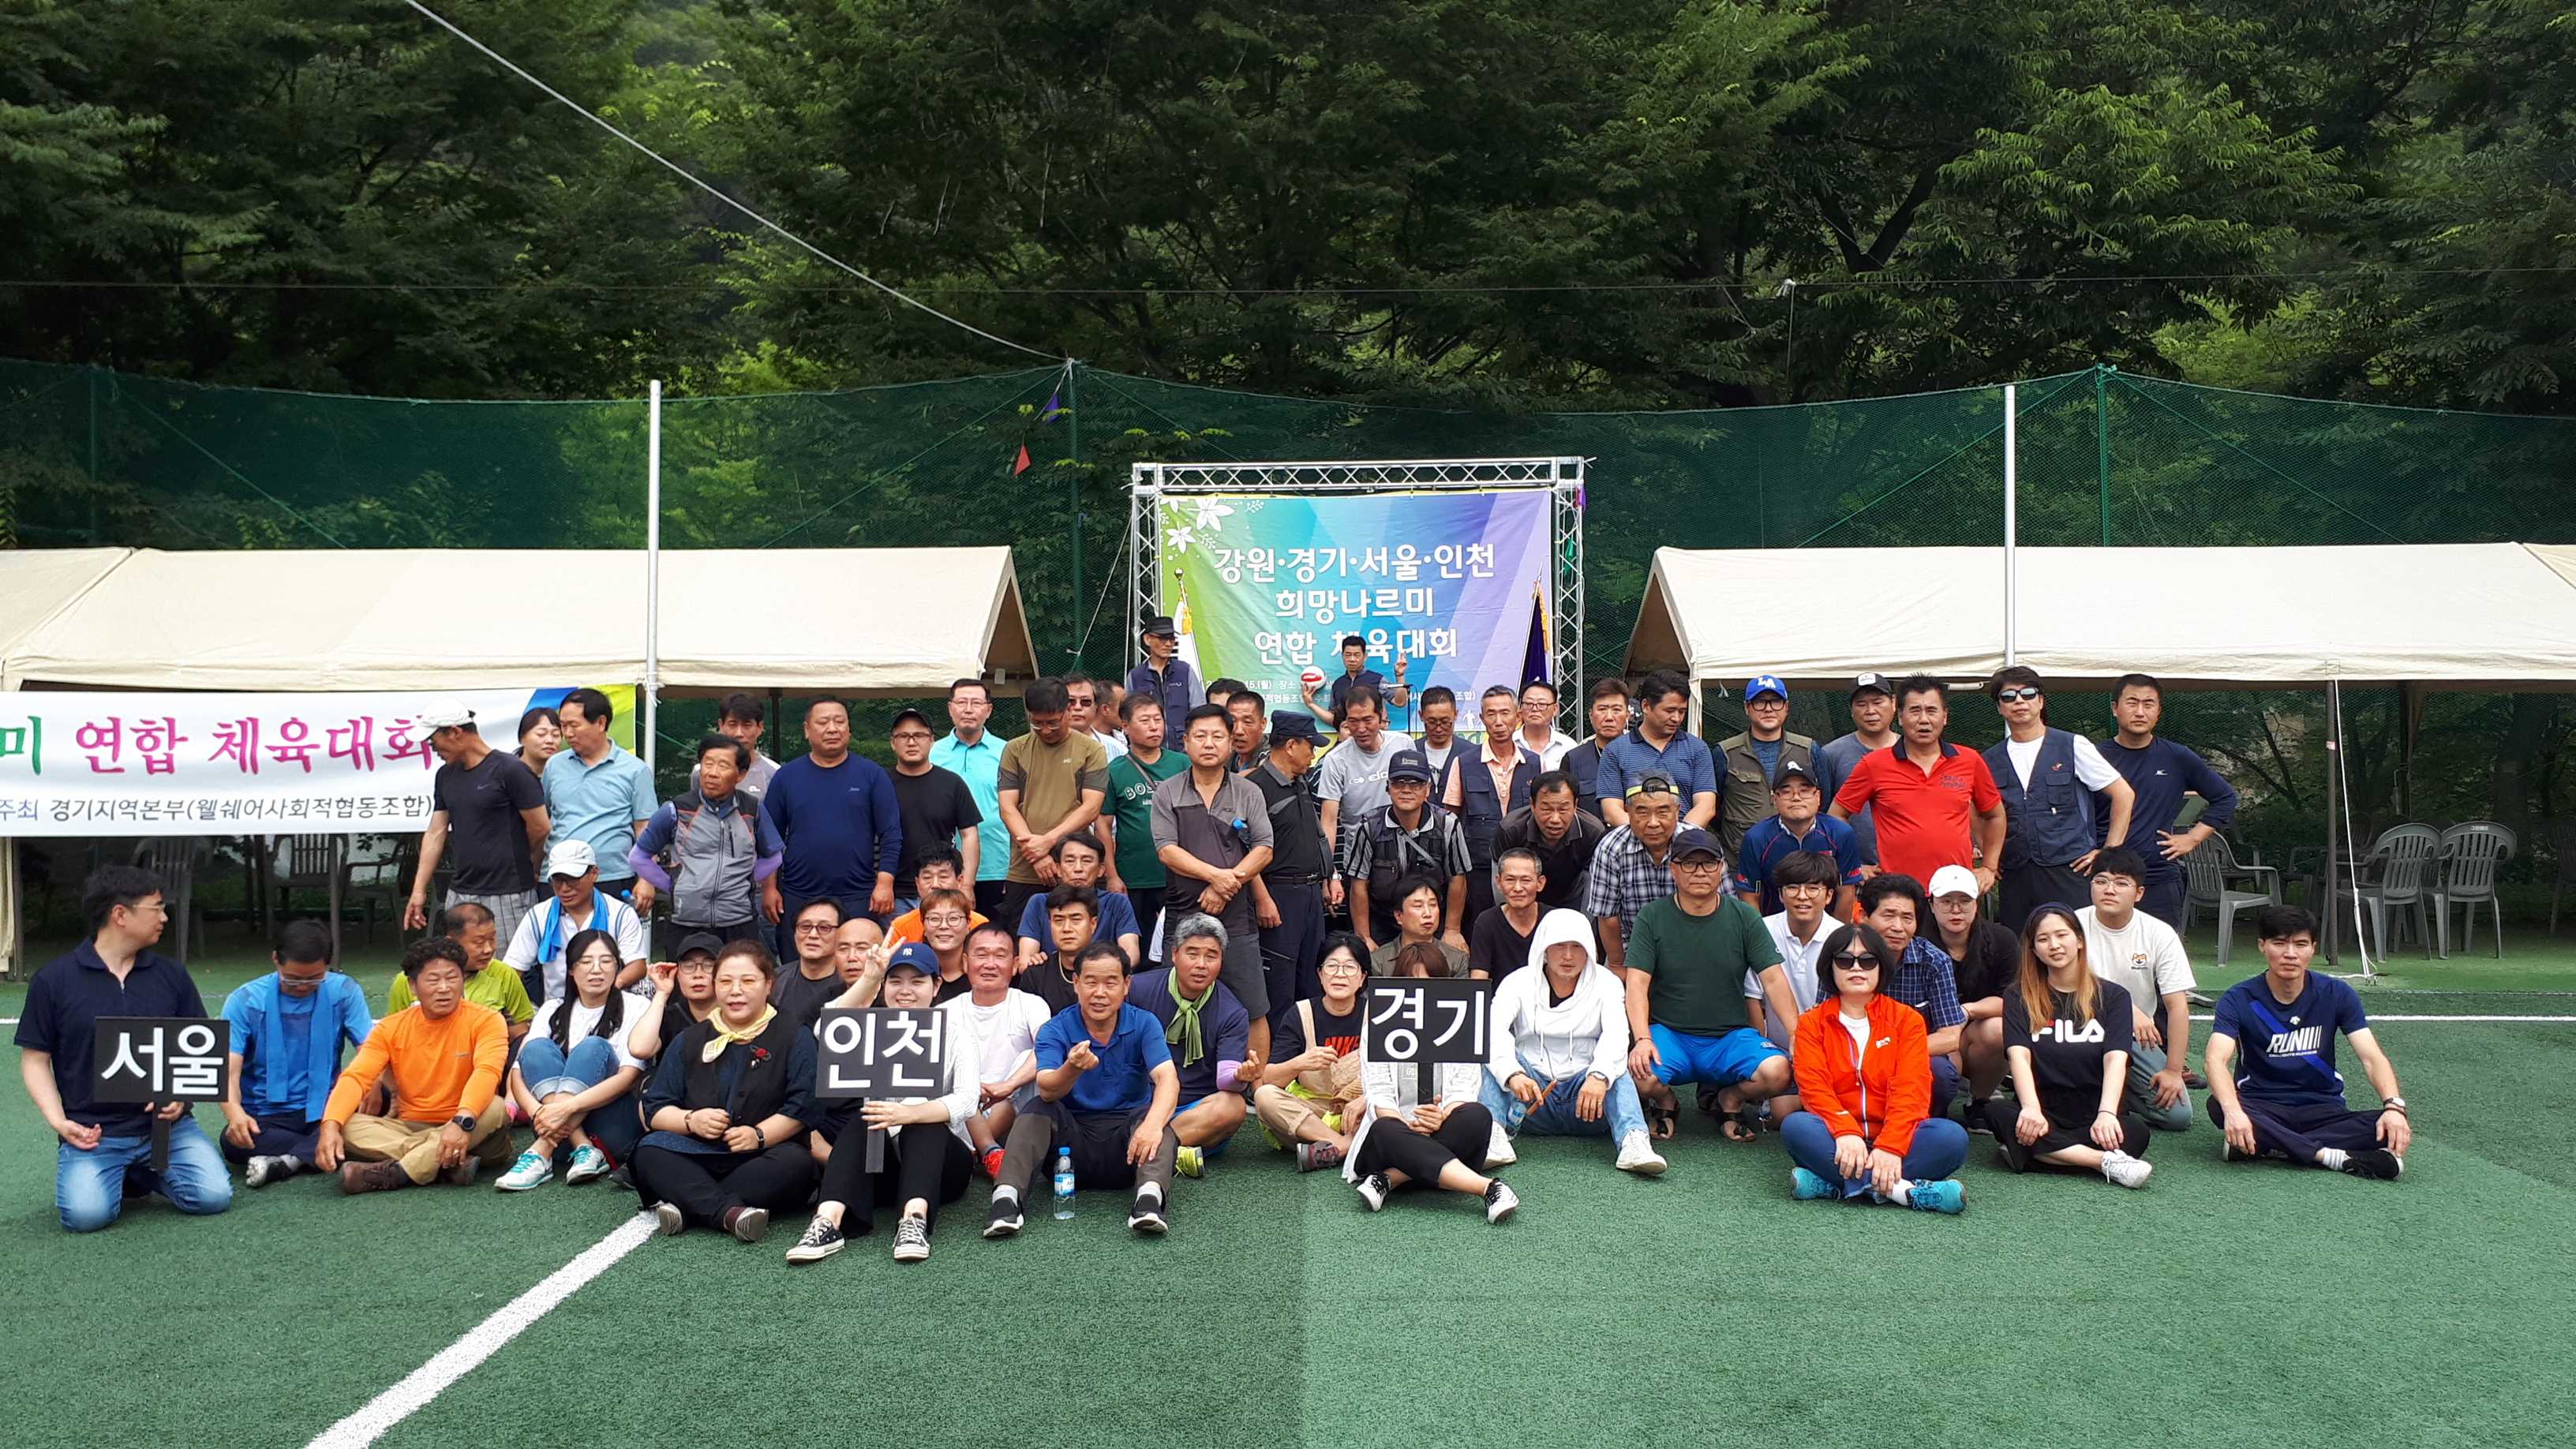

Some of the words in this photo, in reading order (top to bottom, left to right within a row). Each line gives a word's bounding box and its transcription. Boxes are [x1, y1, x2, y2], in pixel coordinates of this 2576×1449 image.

[1213, 543, 1495, 583] 강원·경기·서울·인천
[1275, 587, 1434, 624] 희망나르미
[1254, 631, 1317, 665] 연합
[1279, 680, 1297, 690] 장소
[1758, 676, 1777, 688] LA
[76, 716, 189, 775] 연합
[208, 714, 432, 774] 체육대회
[1370, 987, 1484, 1060] 경기
[2031, 1018, 2106, 1043] FILA
[101, 1024, 224, 1095] 서울
[824, 1010, 942, 1089] 인천
